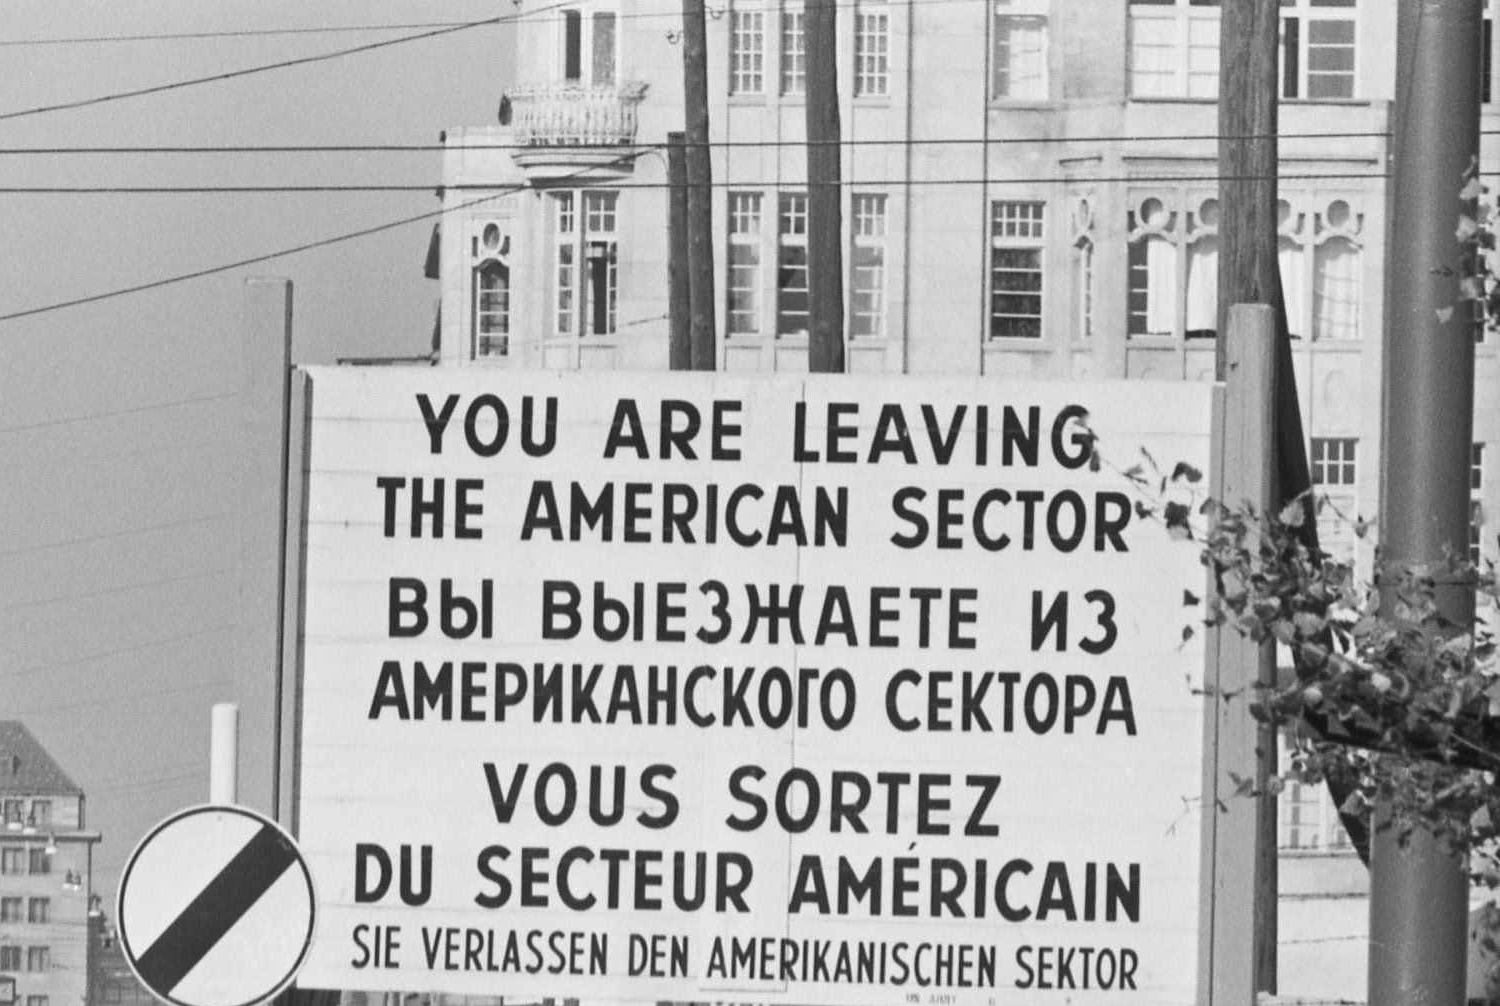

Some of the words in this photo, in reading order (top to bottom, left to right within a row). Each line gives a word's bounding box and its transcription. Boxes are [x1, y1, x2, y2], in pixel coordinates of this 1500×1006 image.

[416, 394, 557, 457] YOU
[604, 399, 741, 460] ARE
[794, 401, 1092, 471] LEAVING
[377, 477, 483, 539] THE
[521, 481, 847, 547] AMERICAN
[891, 487, 1131, 552] SECTOR
[389, 578, 492, 639] ВЫ
[543, 580, 977, 648] ВЫЕЗЖАЕТЕ
[1032, 590, 1117, 654] ИЗ
[369, 661, 855, 730] АМЕРИКАНСКОГО
[886, 669, 1136, 735] СЕКТОРА
[484, 763, 679, 829] VOUS
[726, 766, 1000, 836] SORTEZ
[355, 844, 432, 906] DU
[475, 846, 752, 912] SECTEUR
[788, 842, 1140, 922] AMÉRICAIN
[352, 925, 400, 968] SIE
[422, 928, 607, 974] VERLASSEN
[629, 935, 688, 977] DEN
[708, 937, 995, 987] AMERIKANISCHEN
[1016, 946, 1137, 990] SEKTOR
